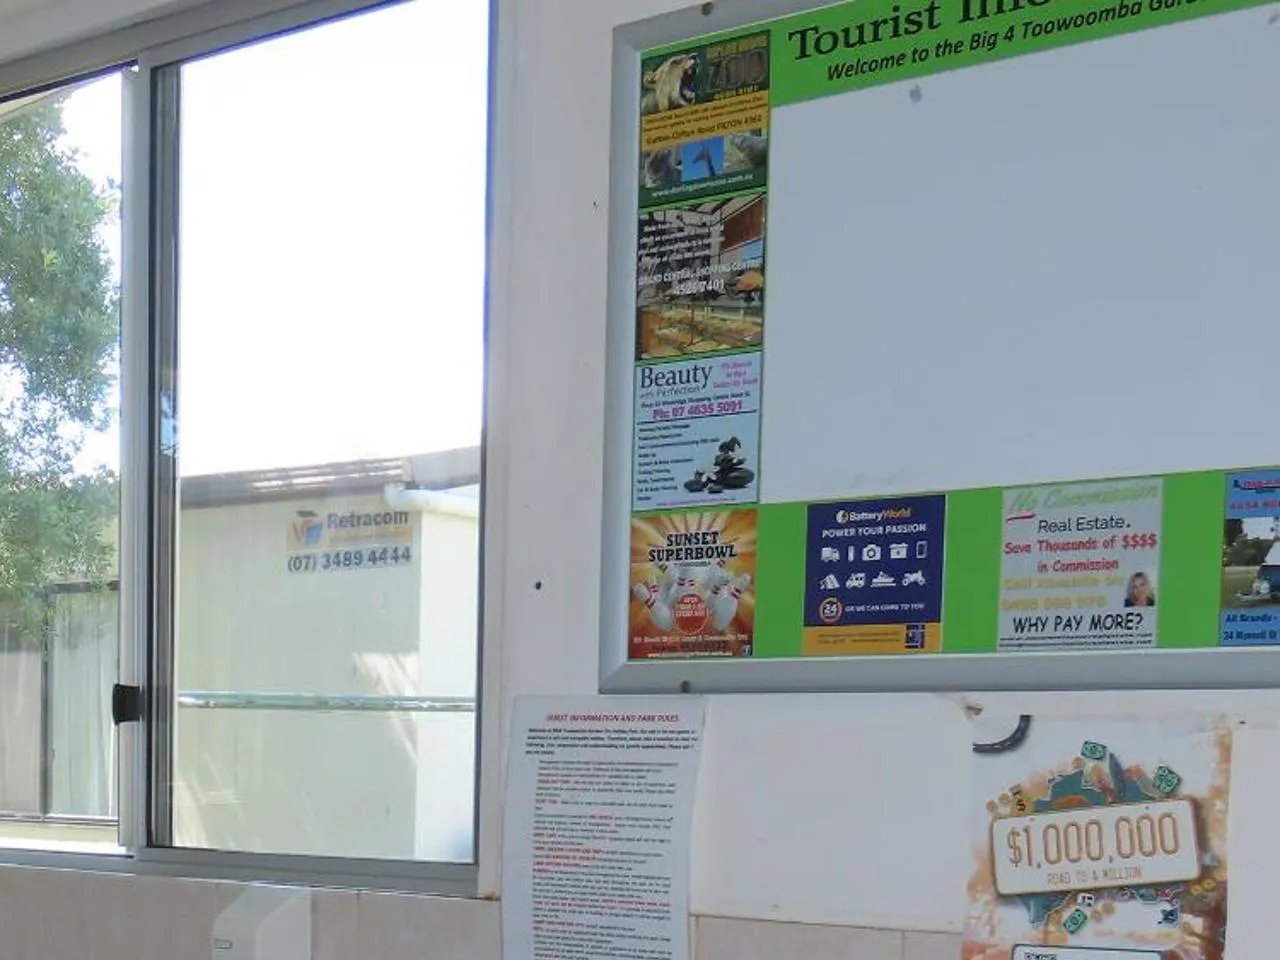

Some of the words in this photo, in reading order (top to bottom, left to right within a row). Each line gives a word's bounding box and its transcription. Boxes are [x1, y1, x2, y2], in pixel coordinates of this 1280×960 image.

[788, 4, 942, 61] Tourist
[827, 53, 906, 81] Welcome
[911, 49, 930, 63] to
[935, 39, 964, 58] the
[970, 31, 998, 51] Big
[1003, 25, 1015, 42] 4
[1022, 0, 1142, 39] Toowoomba
[640, 364, 713, 389] Beauty
[672, 408, 685, 418] 07
[327, 510, 409, 529] Retracom
[1037, 518, 1072, 533] Real
[1076, 515, 1131, 531] Estate.
[666, 531, 719, 547] SUNSET
[822, 527, 856, 538] POWER
[858, 525, 883, 536] YOUR
[885, 523, 927, 534] PASSION
[648, 544, 738, 562] SUPERBOWL
[1004, 541, 1032, 555] Save
[1037, 537, 1097, 553] Thousands
[1102, 535, 1116, 549] of
[1122, 532, 1157, 550] $$$$
[288, 554, 317, 573] (07)
[322, 552, 363, 570] 3489
[368, 545, 412, 565] 4444
[1037, 560, 1048, 573] in
[1052, 557, 1119, 573] Commission
[824, 603, 837, 614] 24
[1013, 615, 1049, 634] WHY
[1053, 615, 1083, 633] PAY
[1089, 612, 1144, 632] MORE?
[1006, 811, 1180, 870] $1,000,000
